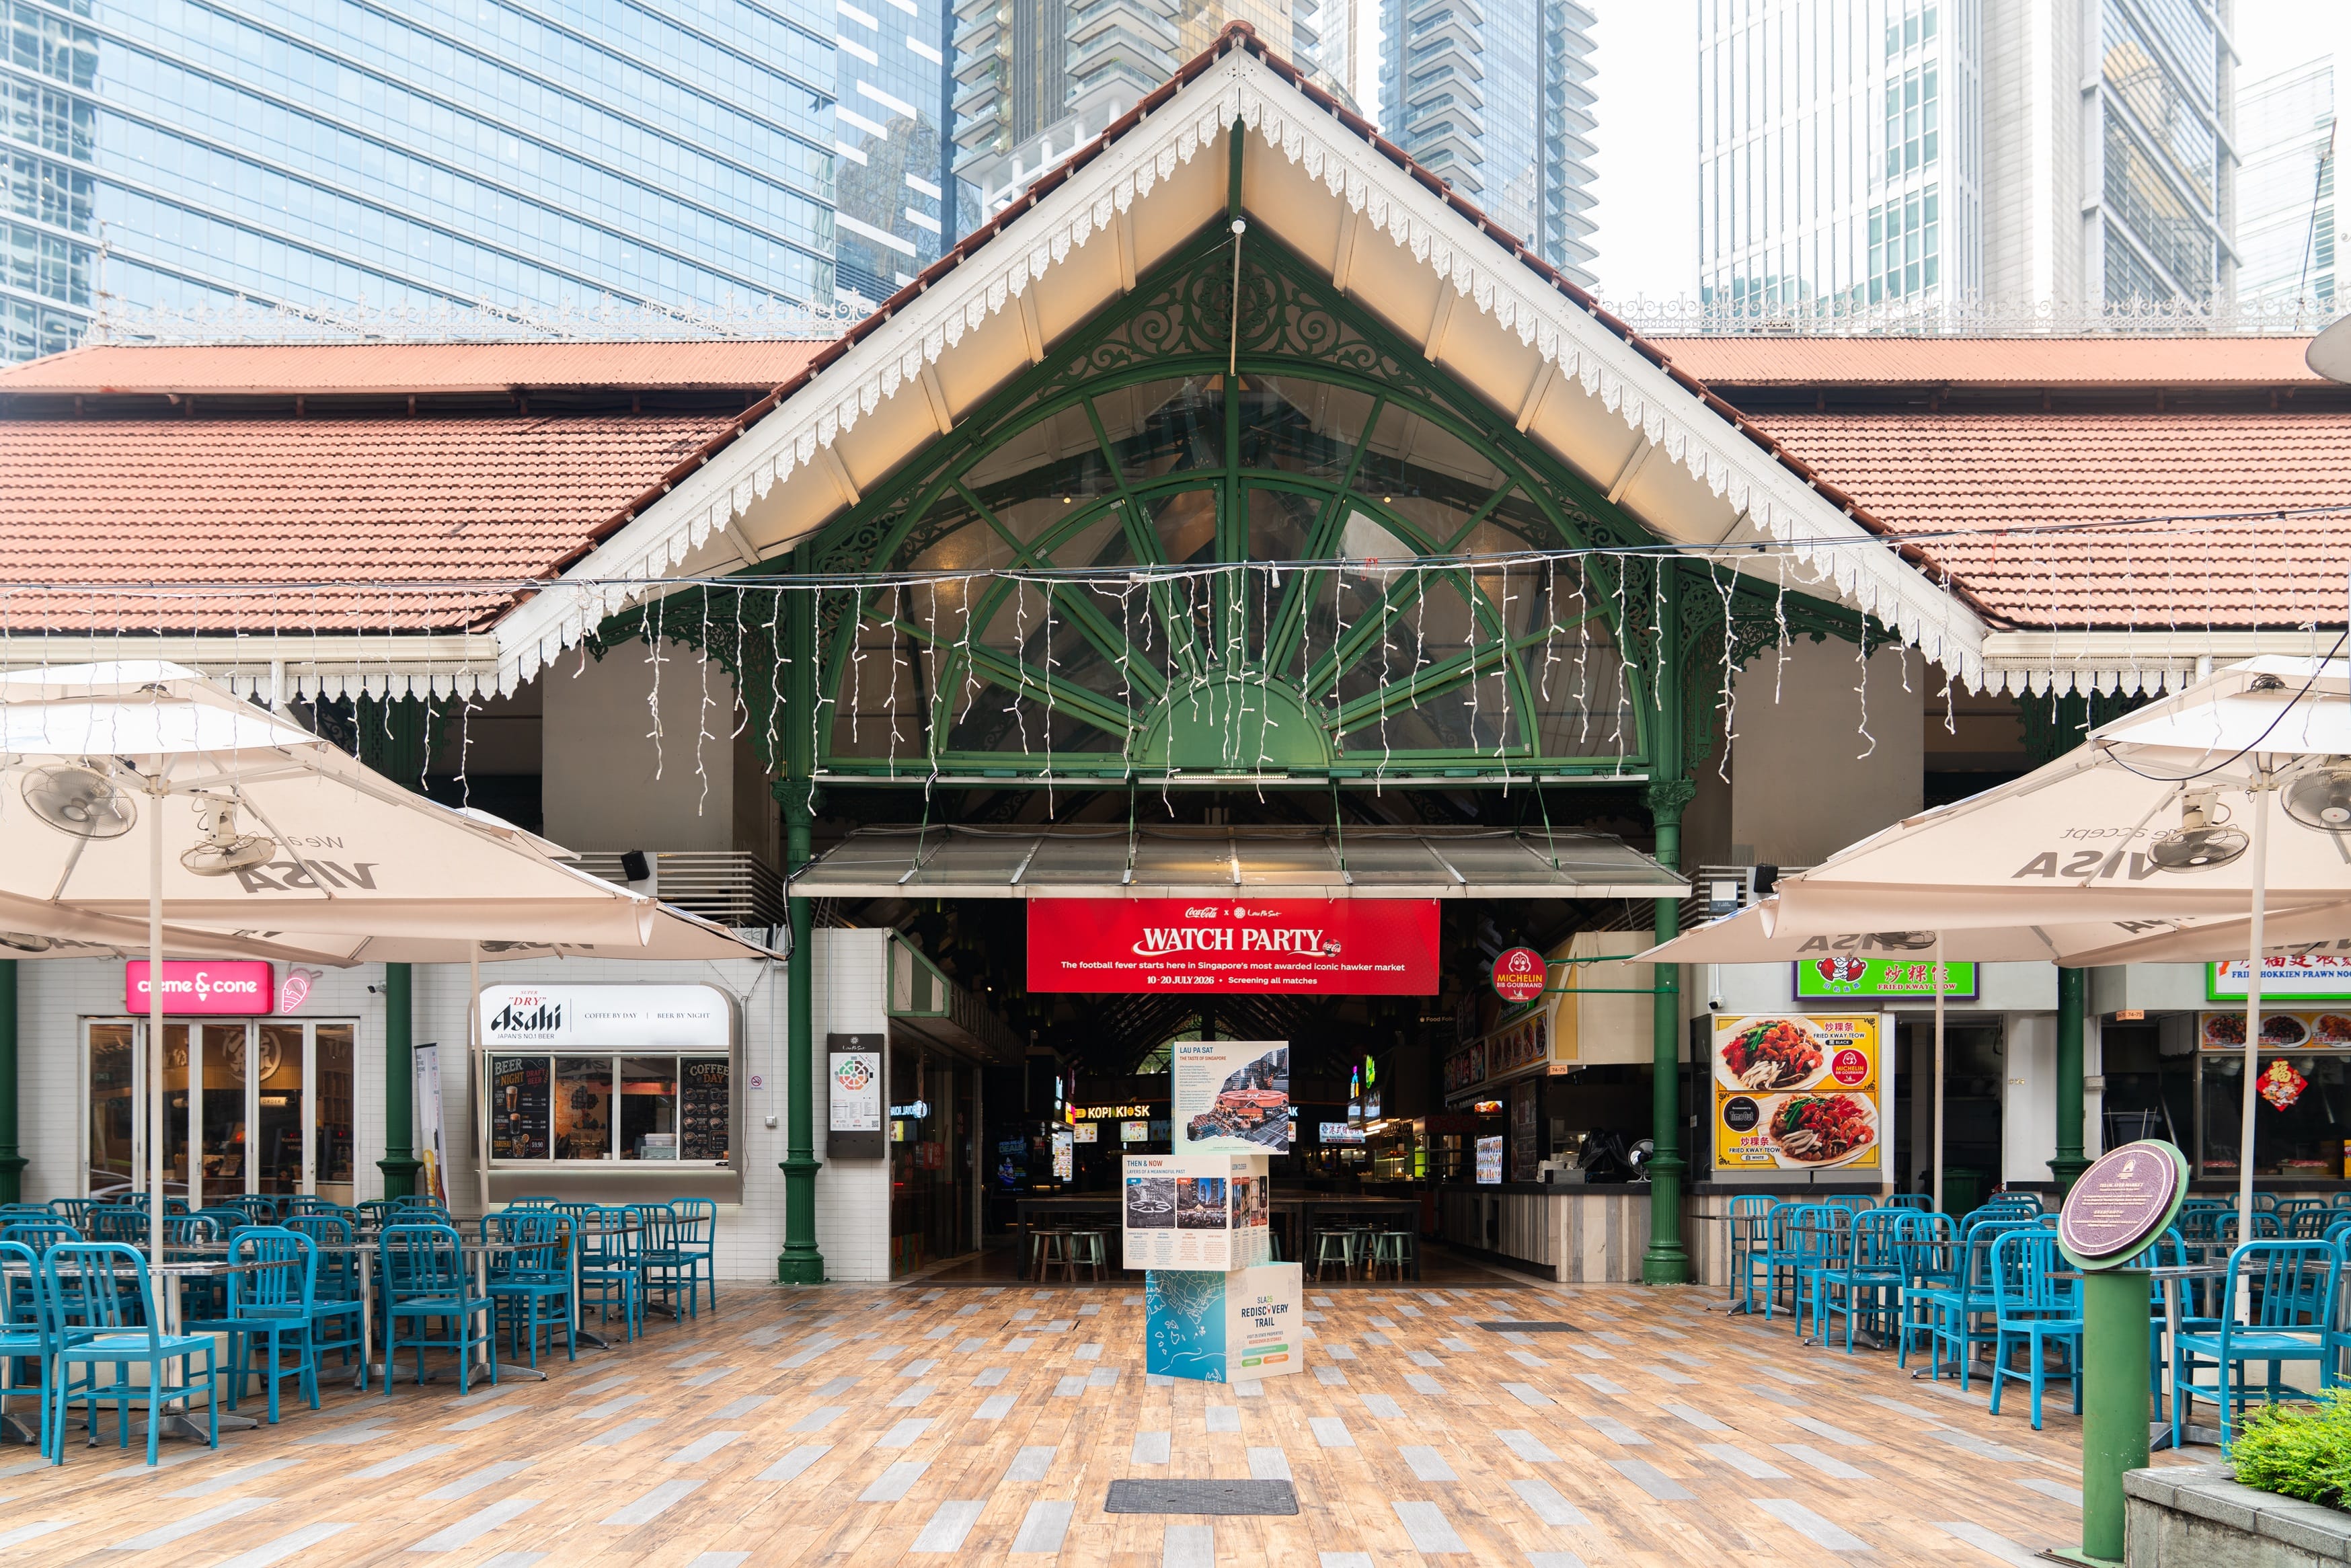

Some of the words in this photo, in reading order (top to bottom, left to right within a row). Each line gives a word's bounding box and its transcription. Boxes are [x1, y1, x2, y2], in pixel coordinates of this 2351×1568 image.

[1143, 928, 1233, 952] WATCH
[1241, 928, 1323, 952] PARTY
[1079, 961, 1113, 969] football
[1198, 962, 1248, 970] Singapore's
[1194, 976, 1215, 984] 2026
[1228, 977, 1269, 985] Screening
[1497, 974, 1543, 982] MICHELIN
[138, 981, 193, 992] cme
[213, 981, 258, 993] cone
[491, 1003, 561, 1031] Asahi
[1825, 1022, 1853, 1031] 炒粿条
[495, 1058, 523, 1075] BEER
[690, 1064, 729, 1076] COFFEE
[2268, 1060, 2292, 1083] 福
[500, 1071, 524, 1087] NIGHT
[527, 1076, 542, 1085] BEER
[703, 1073, 724, 1084] DAY
[1087, 1107, 1112, 1119] KOPI
[1740, 1137, 1769, 1146] 炒粿条
[1257, 1295, 1273, 1304] SLA25
[1255, 1317, 1275, 1328] TRAIL
